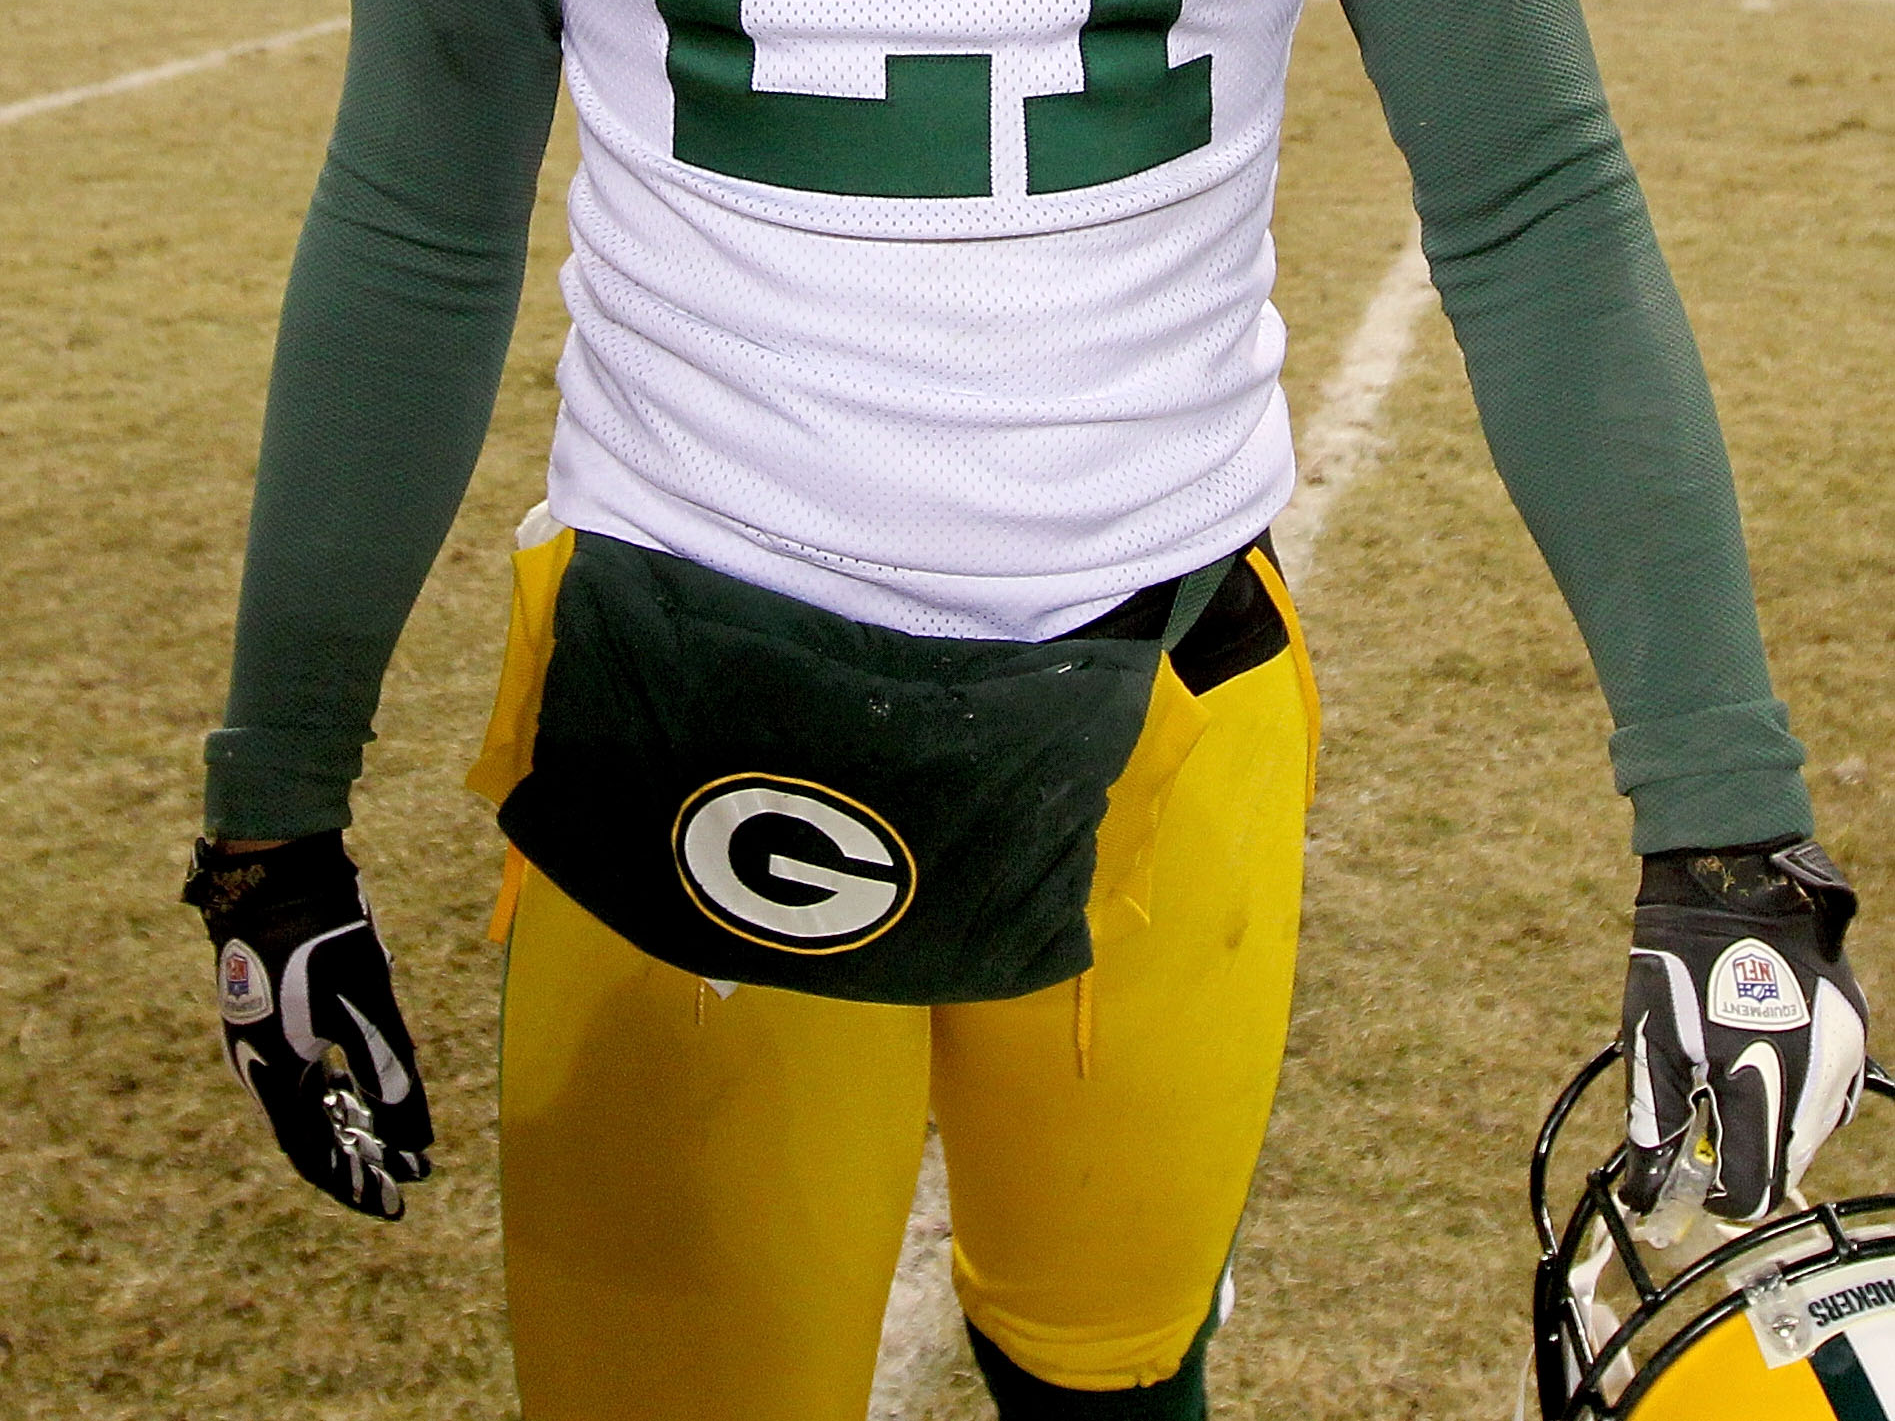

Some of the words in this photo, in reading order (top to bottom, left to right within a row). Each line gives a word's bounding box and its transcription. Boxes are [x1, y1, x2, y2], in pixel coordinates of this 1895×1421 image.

[685, 788, 897, 938] G
[1735, 959, 1774, 983] NFL
[1722, 1001, 1798, 1018] EQUIPMENT
